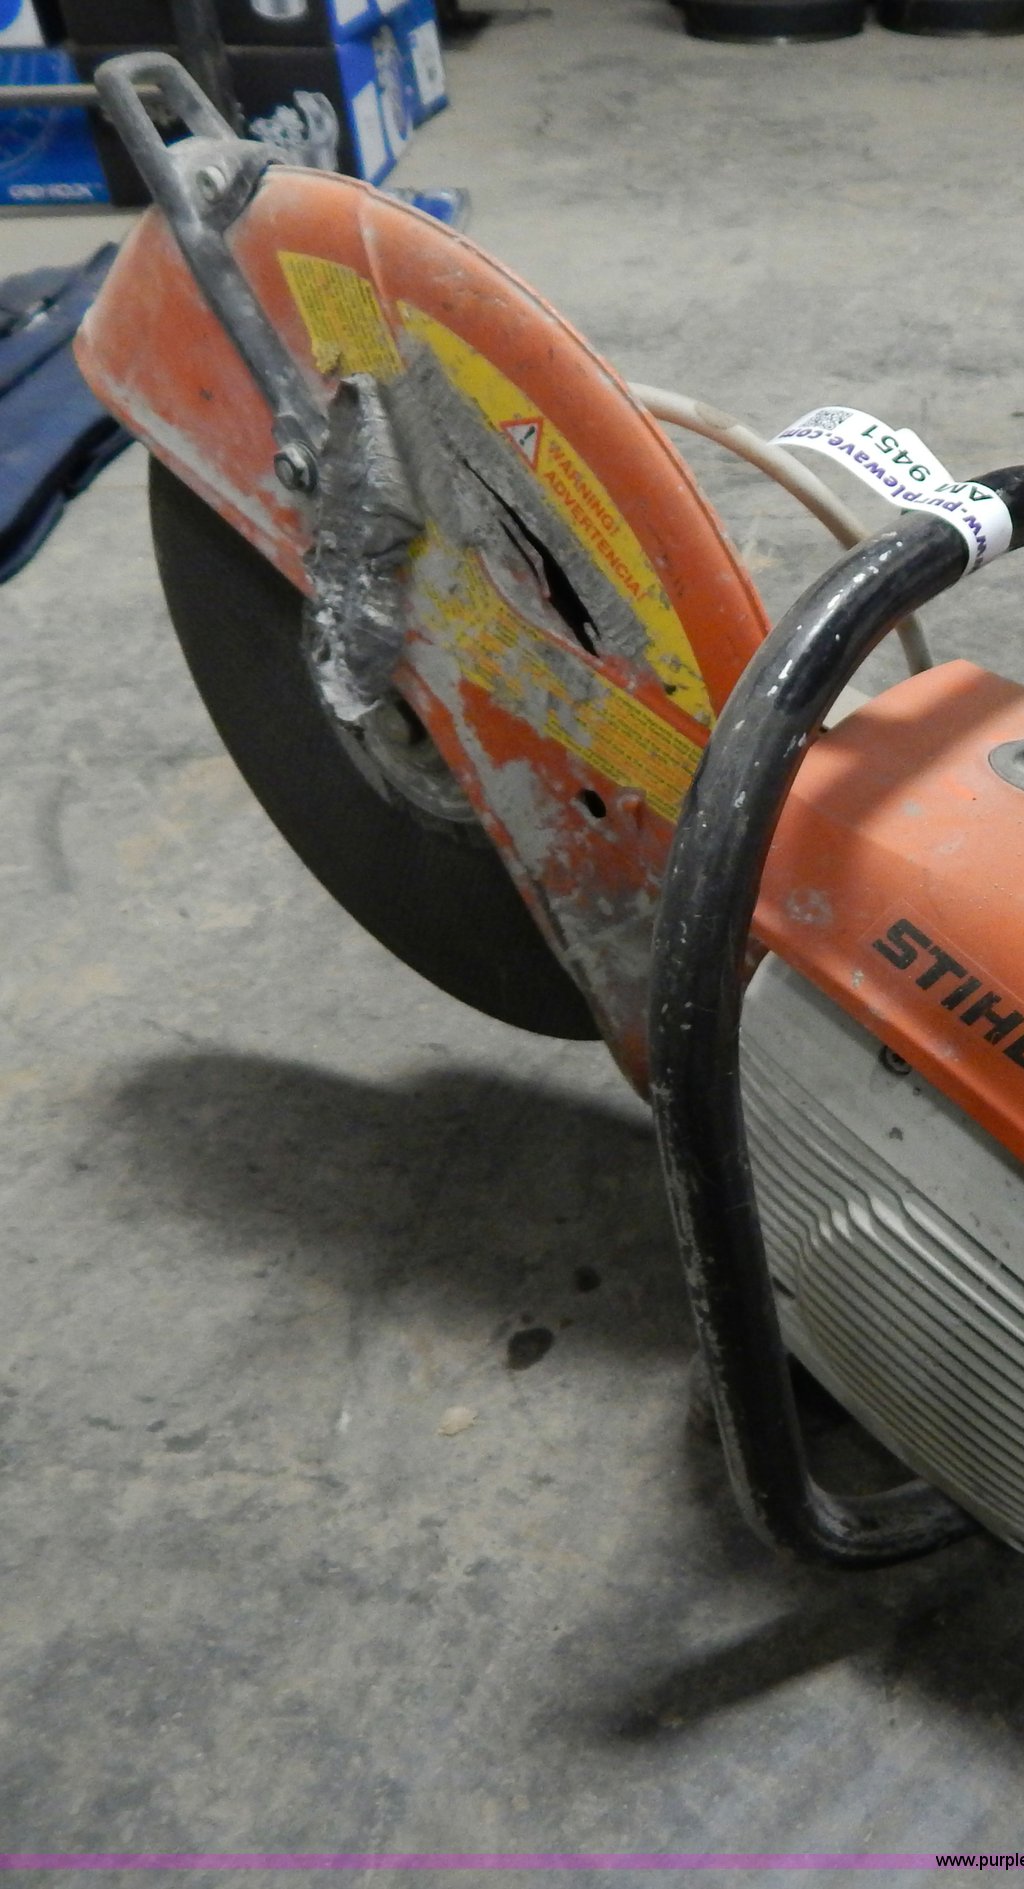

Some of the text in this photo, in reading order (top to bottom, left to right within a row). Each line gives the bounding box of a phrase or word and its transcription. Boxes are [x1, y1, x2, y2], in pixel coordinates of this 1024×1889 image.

[547, 440, 621, 538] WARNING!
[860, 424, 995, 502] AM 9451
